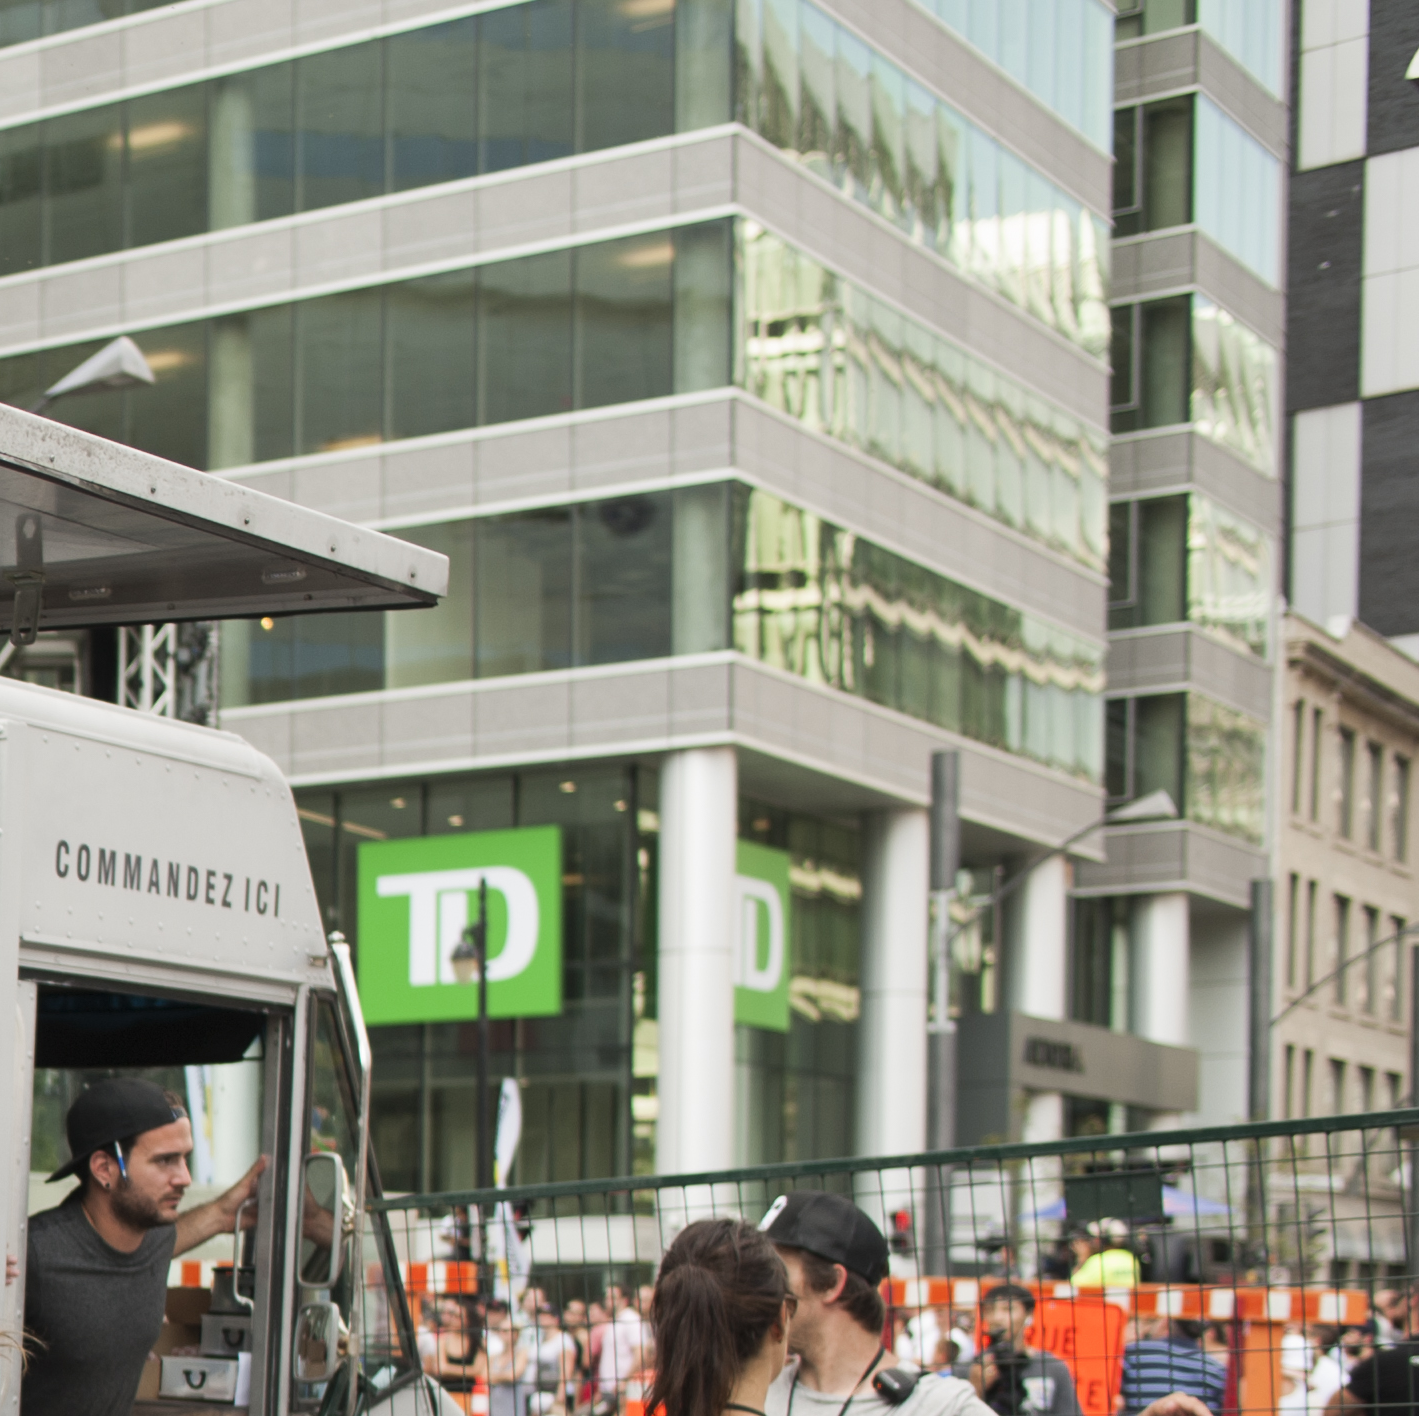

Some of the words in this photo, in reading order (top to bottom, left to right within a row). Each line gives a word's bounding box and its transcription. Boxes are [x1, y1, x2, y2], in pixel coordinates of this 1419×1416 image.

[55, 839, 234, 909] COMMANDEZ
[243, 876, 281, 919] ICI
[375, 864, 540, 988] TD
